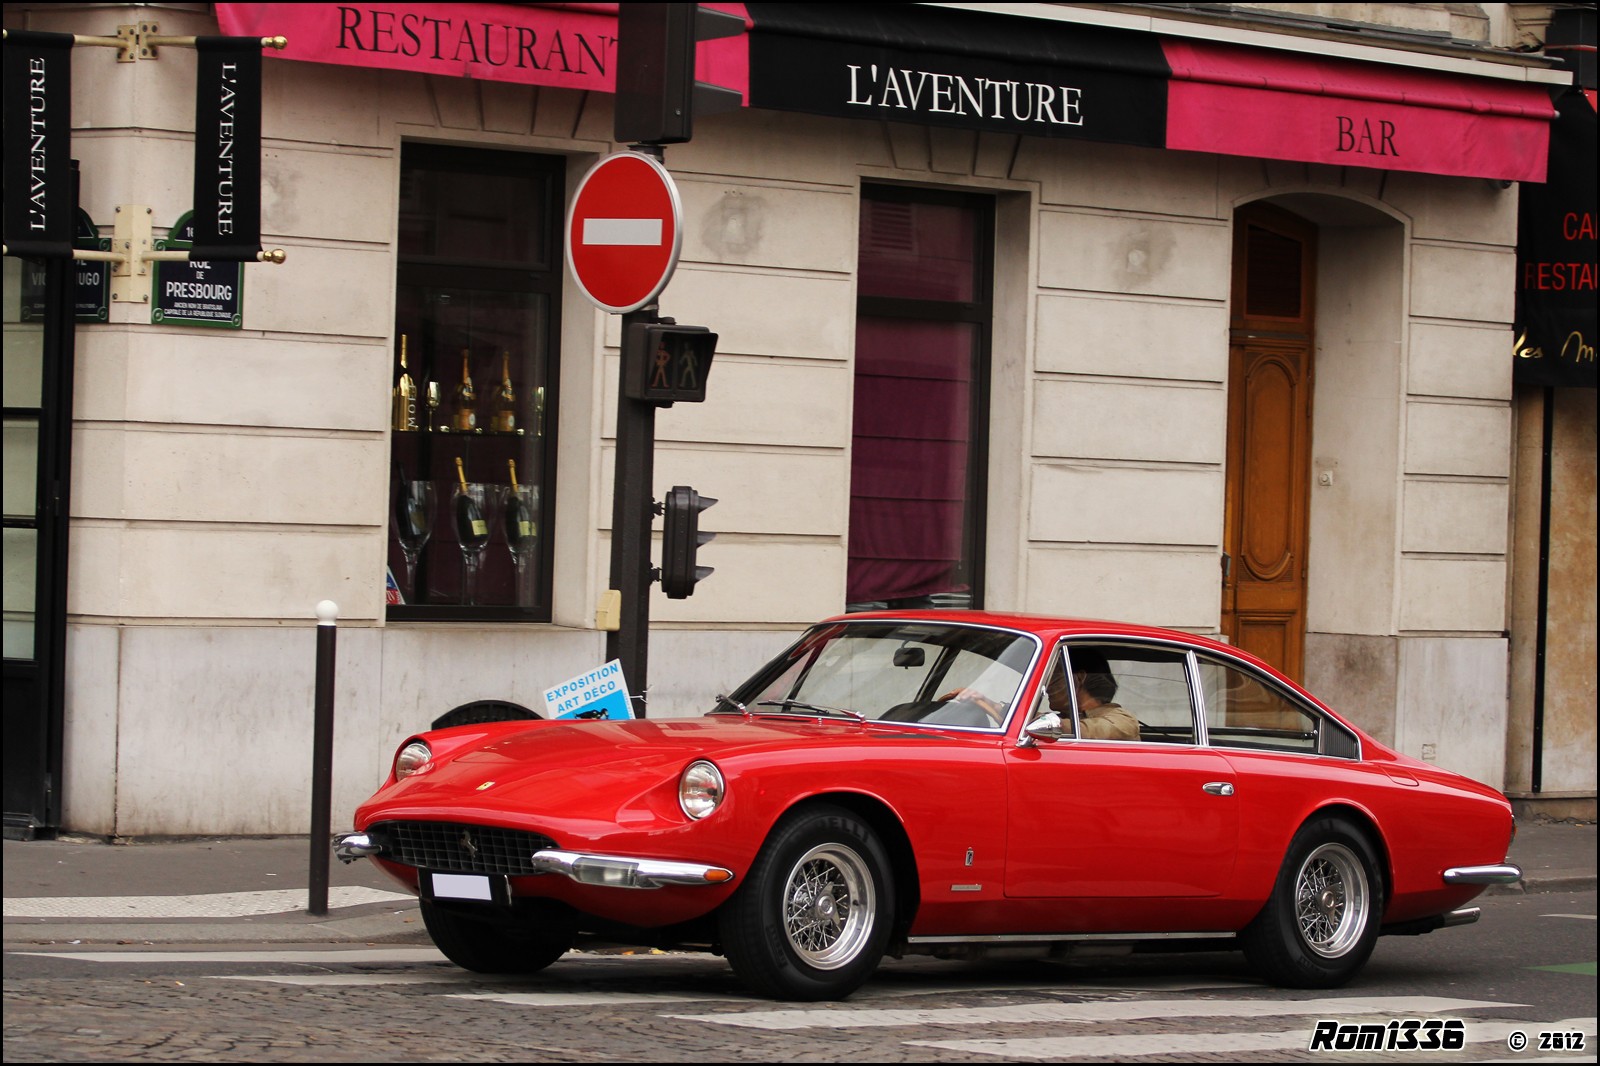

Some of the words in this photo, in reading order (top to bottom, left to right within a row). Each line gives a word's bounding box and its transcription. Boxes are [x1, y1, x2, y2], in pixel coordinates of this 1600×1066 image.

[846, 64, 1084, 126] L'AVENTURE
[30, 57, 46, 231] L'AVENTURE
[217, 62, 237, 236] L'AVENTURE
[1335, 115, 1400, 157] BAR
[1563, 212, 1597, 241] CA
[78, 272, 100, 286] UGO
[166, 281, 232, 301] PRESBOURG
[196, 271, 205, 280] DE
[546, 663, 619, 702] EXPOSITION
[557, 696, 579, 713] ART
[583, 680, 616, 701] DÉCO
